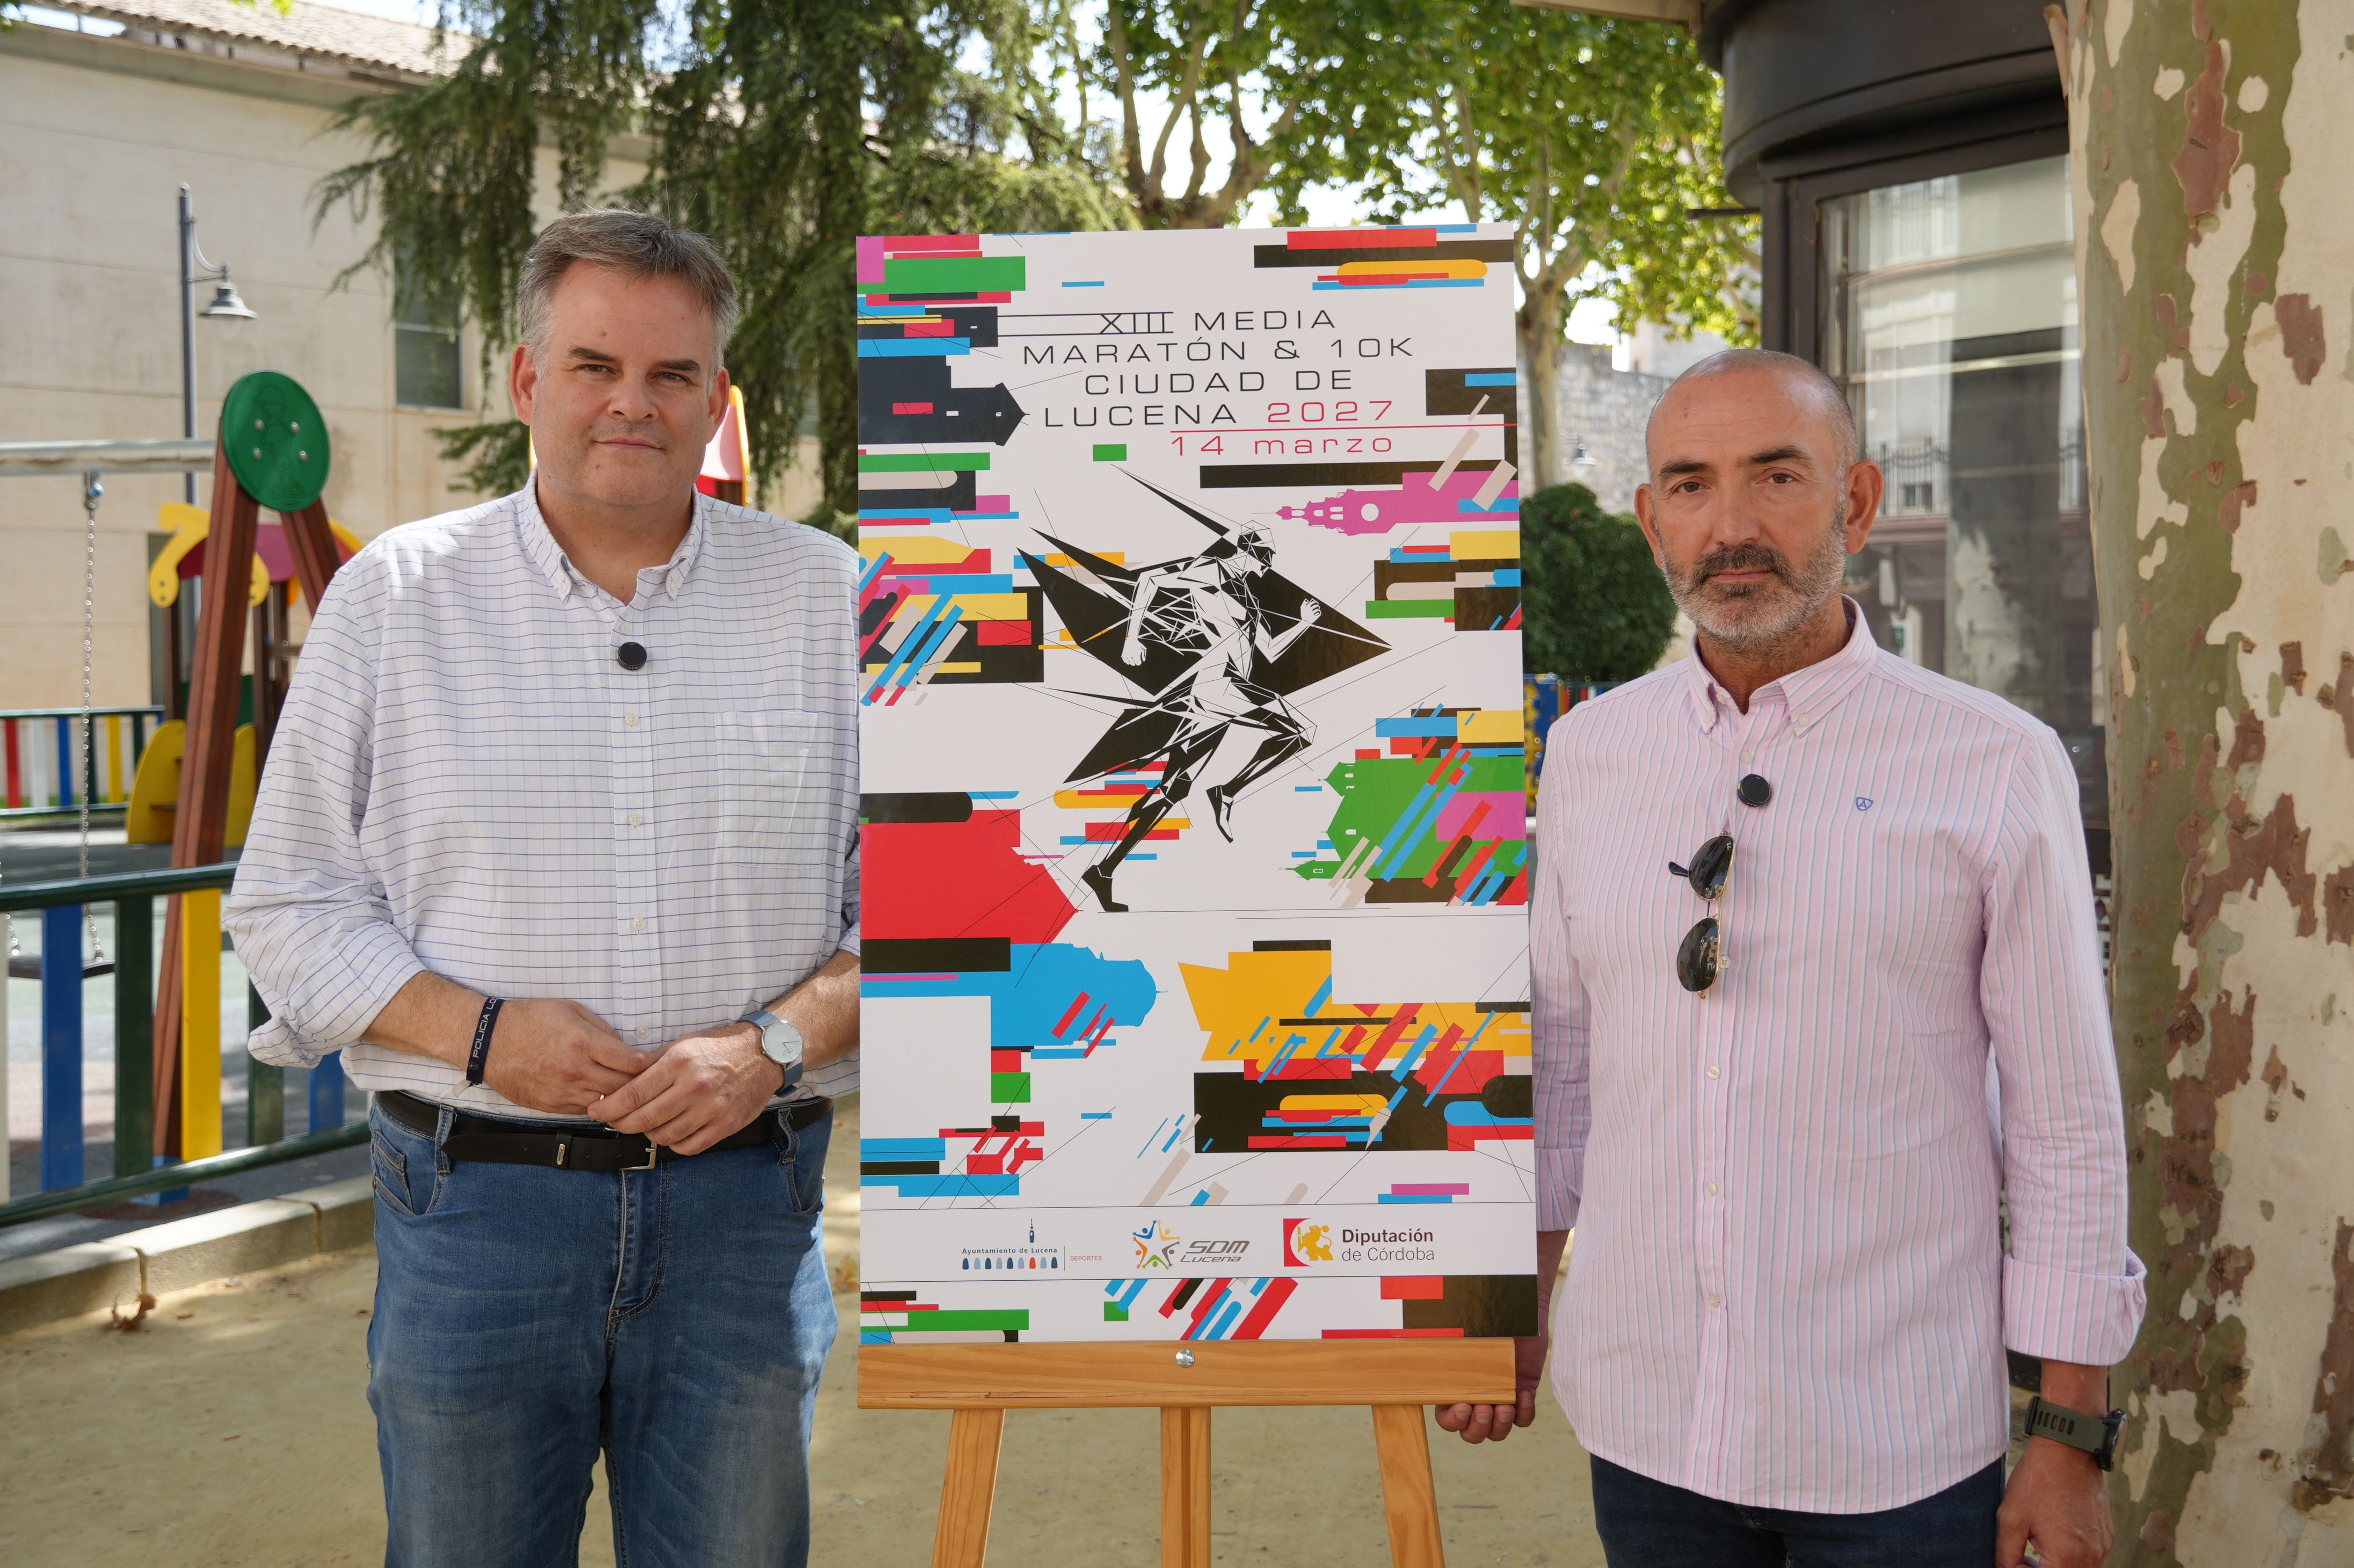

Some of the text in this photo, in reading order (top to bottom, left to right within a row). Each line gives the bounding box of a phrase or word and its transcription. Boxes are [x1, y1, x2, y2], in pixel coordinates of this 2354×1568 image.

[1099, 309, 1335, 335] XIII MEDIA
[1023, 337, 1413, 365] MARATÓN & 10K
[1085, 369, 1352, 395] CIUDAD DE
[1044, 400, 1392, 427] LUCENA 2027
[1171, 435, 1392, 456] 14 marzo
[473, 1014, 490, 1058] POLICIA
[1185, 1240, 1250, 1254] SDM
[1342, 1228, 1433, 1246] Diputación
[962, 1247, 1016, 1255] Ayuntamiento
[1180, 1254, 1242, 1262] Lucena
[1342, 1247, 1434, 1261] de Córdoba
